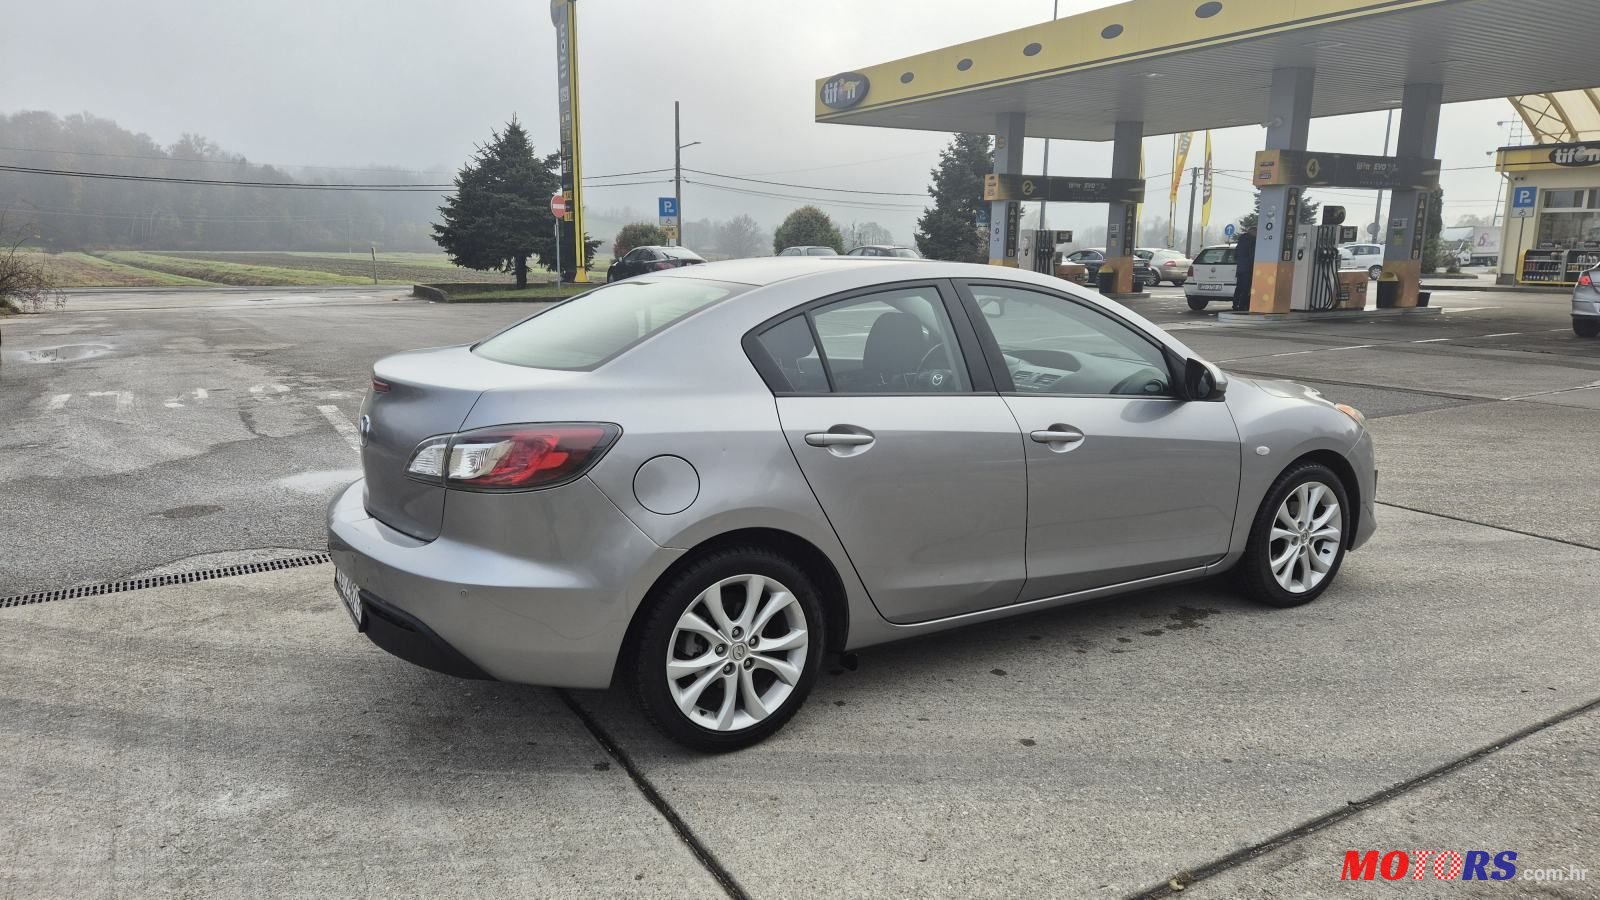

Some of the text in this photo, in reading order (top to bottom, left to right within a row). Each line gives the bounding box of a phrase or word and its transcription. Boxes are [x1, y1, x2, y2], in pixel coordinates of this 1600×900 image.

[1554, 145, 1600, 164] tifon
[1519, 190, 1530, 204] P
[663, 200, 672, 213] P
